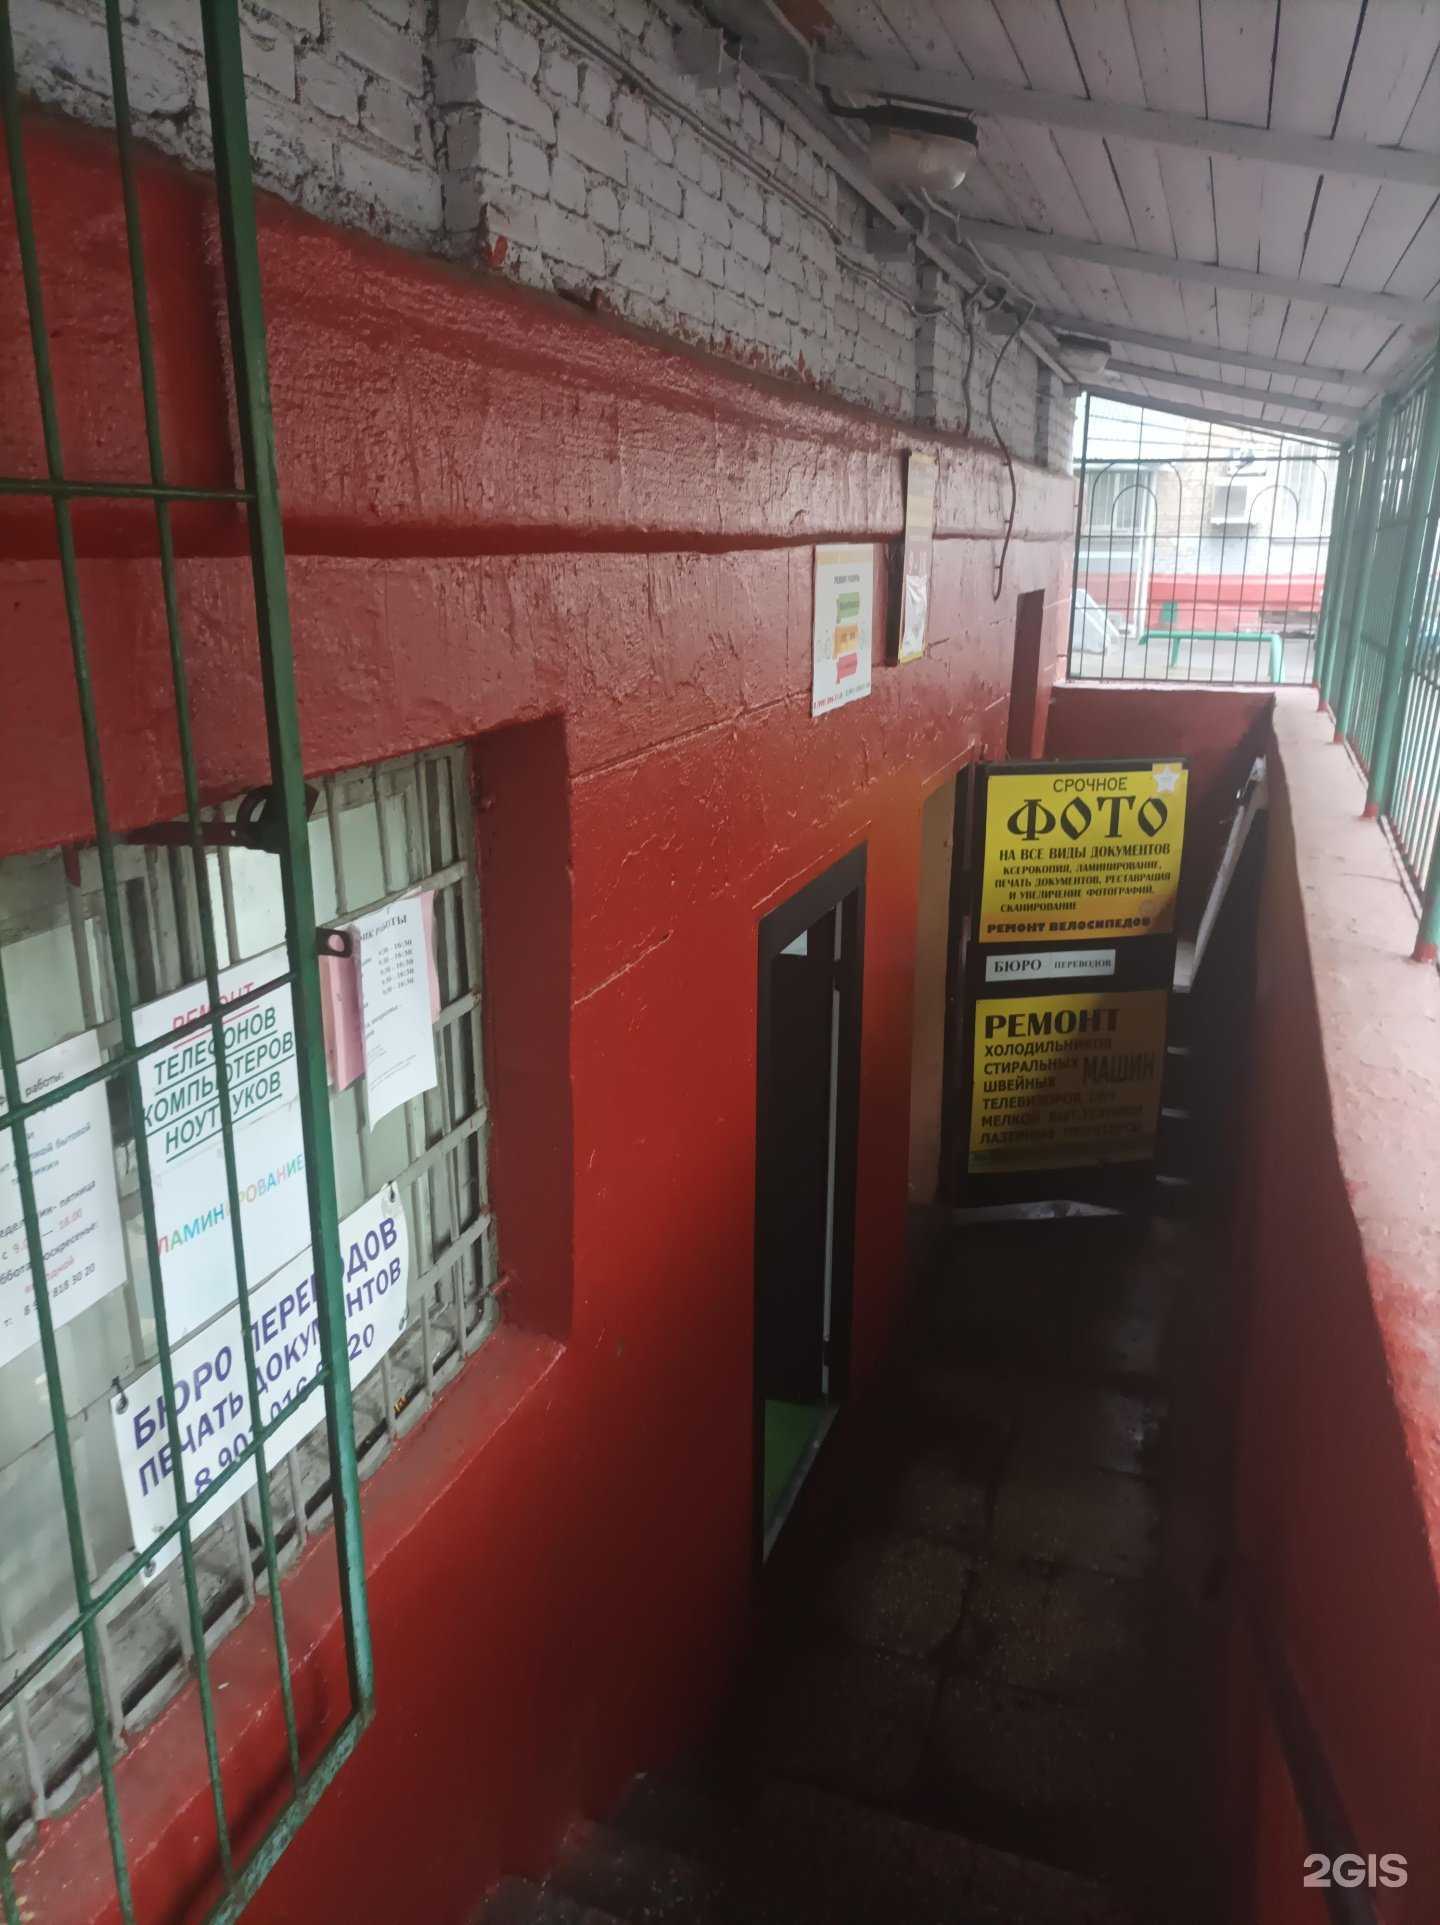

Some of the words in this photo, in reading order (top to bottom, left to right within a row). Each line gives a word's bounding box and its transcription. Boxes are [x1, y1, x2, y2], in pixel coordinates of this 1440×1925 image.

[1053, 776, 1128, 792] СРОЧНОЕ
[1007, 796, 1168, 841] ФОТО
[999, 849, 1016, 861] НА
[1020, 848, 1043, 860] ВСЕ
[1049, 847, 1087, 859] ВИДЫ
[1091, 843, 1171, 858] ДОКУМЕНТОВ
[994, 877, 1032, 888] ПЕЧАТЬ
[1008, 889, 1017, 900] И
[987, 921, 1046, 934] РЕМОНТ
[1049, 916, 1151, 932] ВЕЛОСИПЕДОВ
[994, 959, 1042, 973] БЮРО
[984, 1008, 1120, 1040] РЕМОНТ
[984, 1038, 1112, 1058] ХОЛОДИЛЬНИОВ
[165, 1071, 281, 1154] НОУТУКОВ
[133, 1346, 232, 1450] БЮРО
[250, 1217, 397, 1352] ПЕРЕДОВ
[138, 1391, 244, 1497] ПЕЧАТЬ
[255, 1257, 401, 1396] ДОКУНТОВ
[218, 1428, 250, 1469] 90
